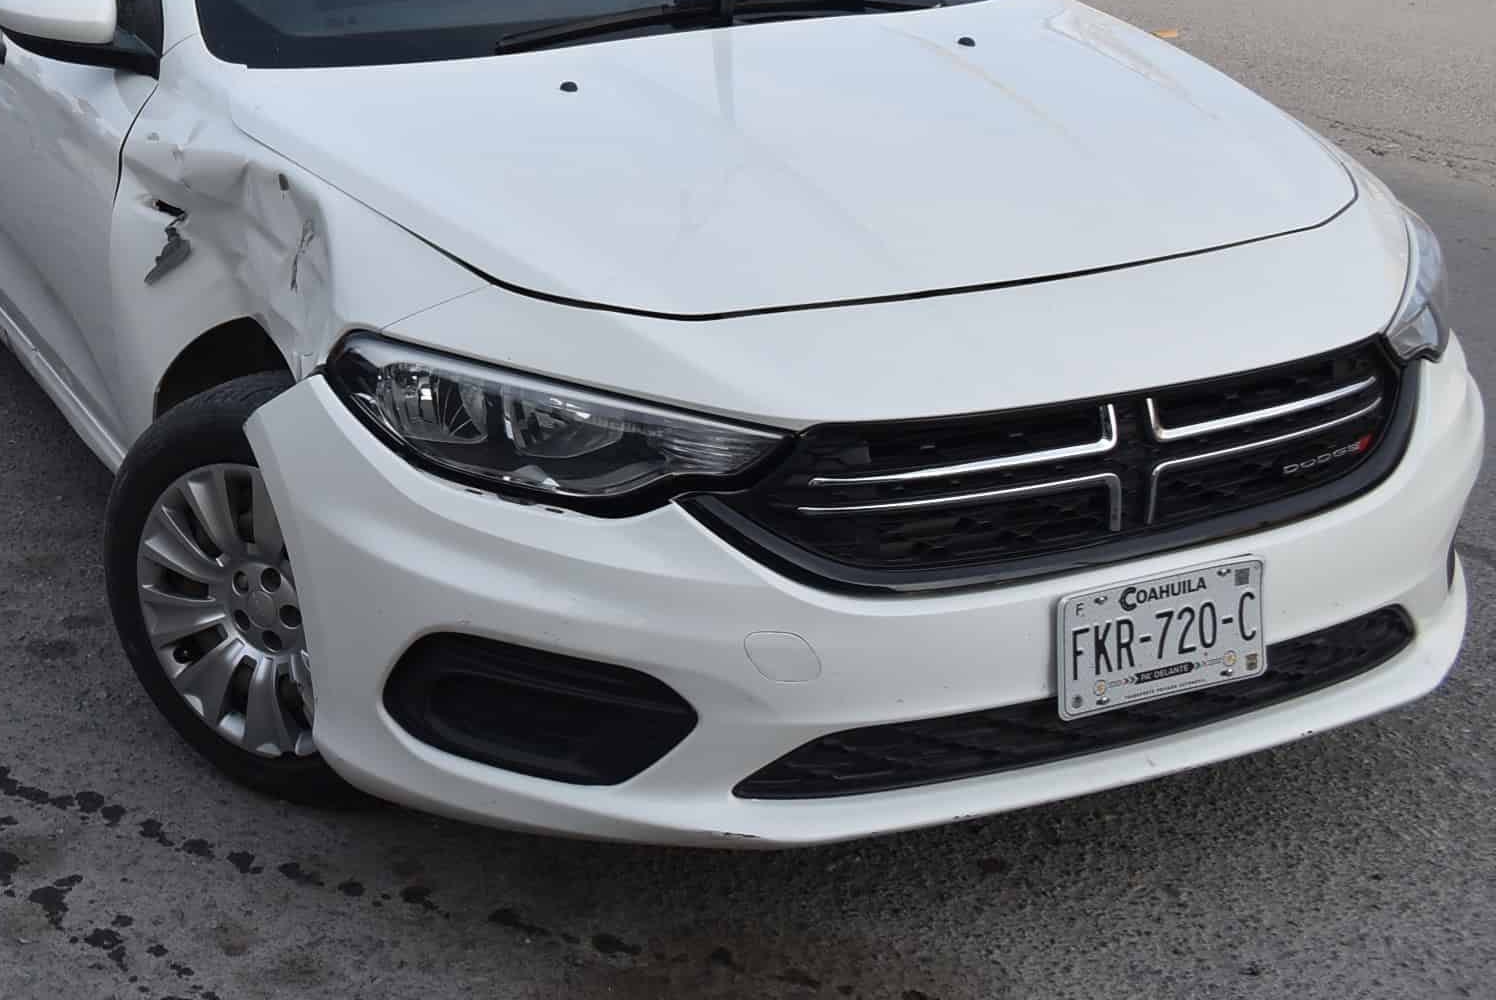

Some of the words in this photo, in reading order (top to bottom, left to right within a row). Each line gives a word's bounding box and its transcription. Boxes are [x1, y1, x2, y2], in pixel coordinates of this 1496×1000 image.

[1282, 441, 1362, 475] DODGE
[1119, 576, 1207, 612] COAHUILA
[1071, 591, 1257, 681] FKR-720-C
[1154, 664, 1189, 679] DELANTE
